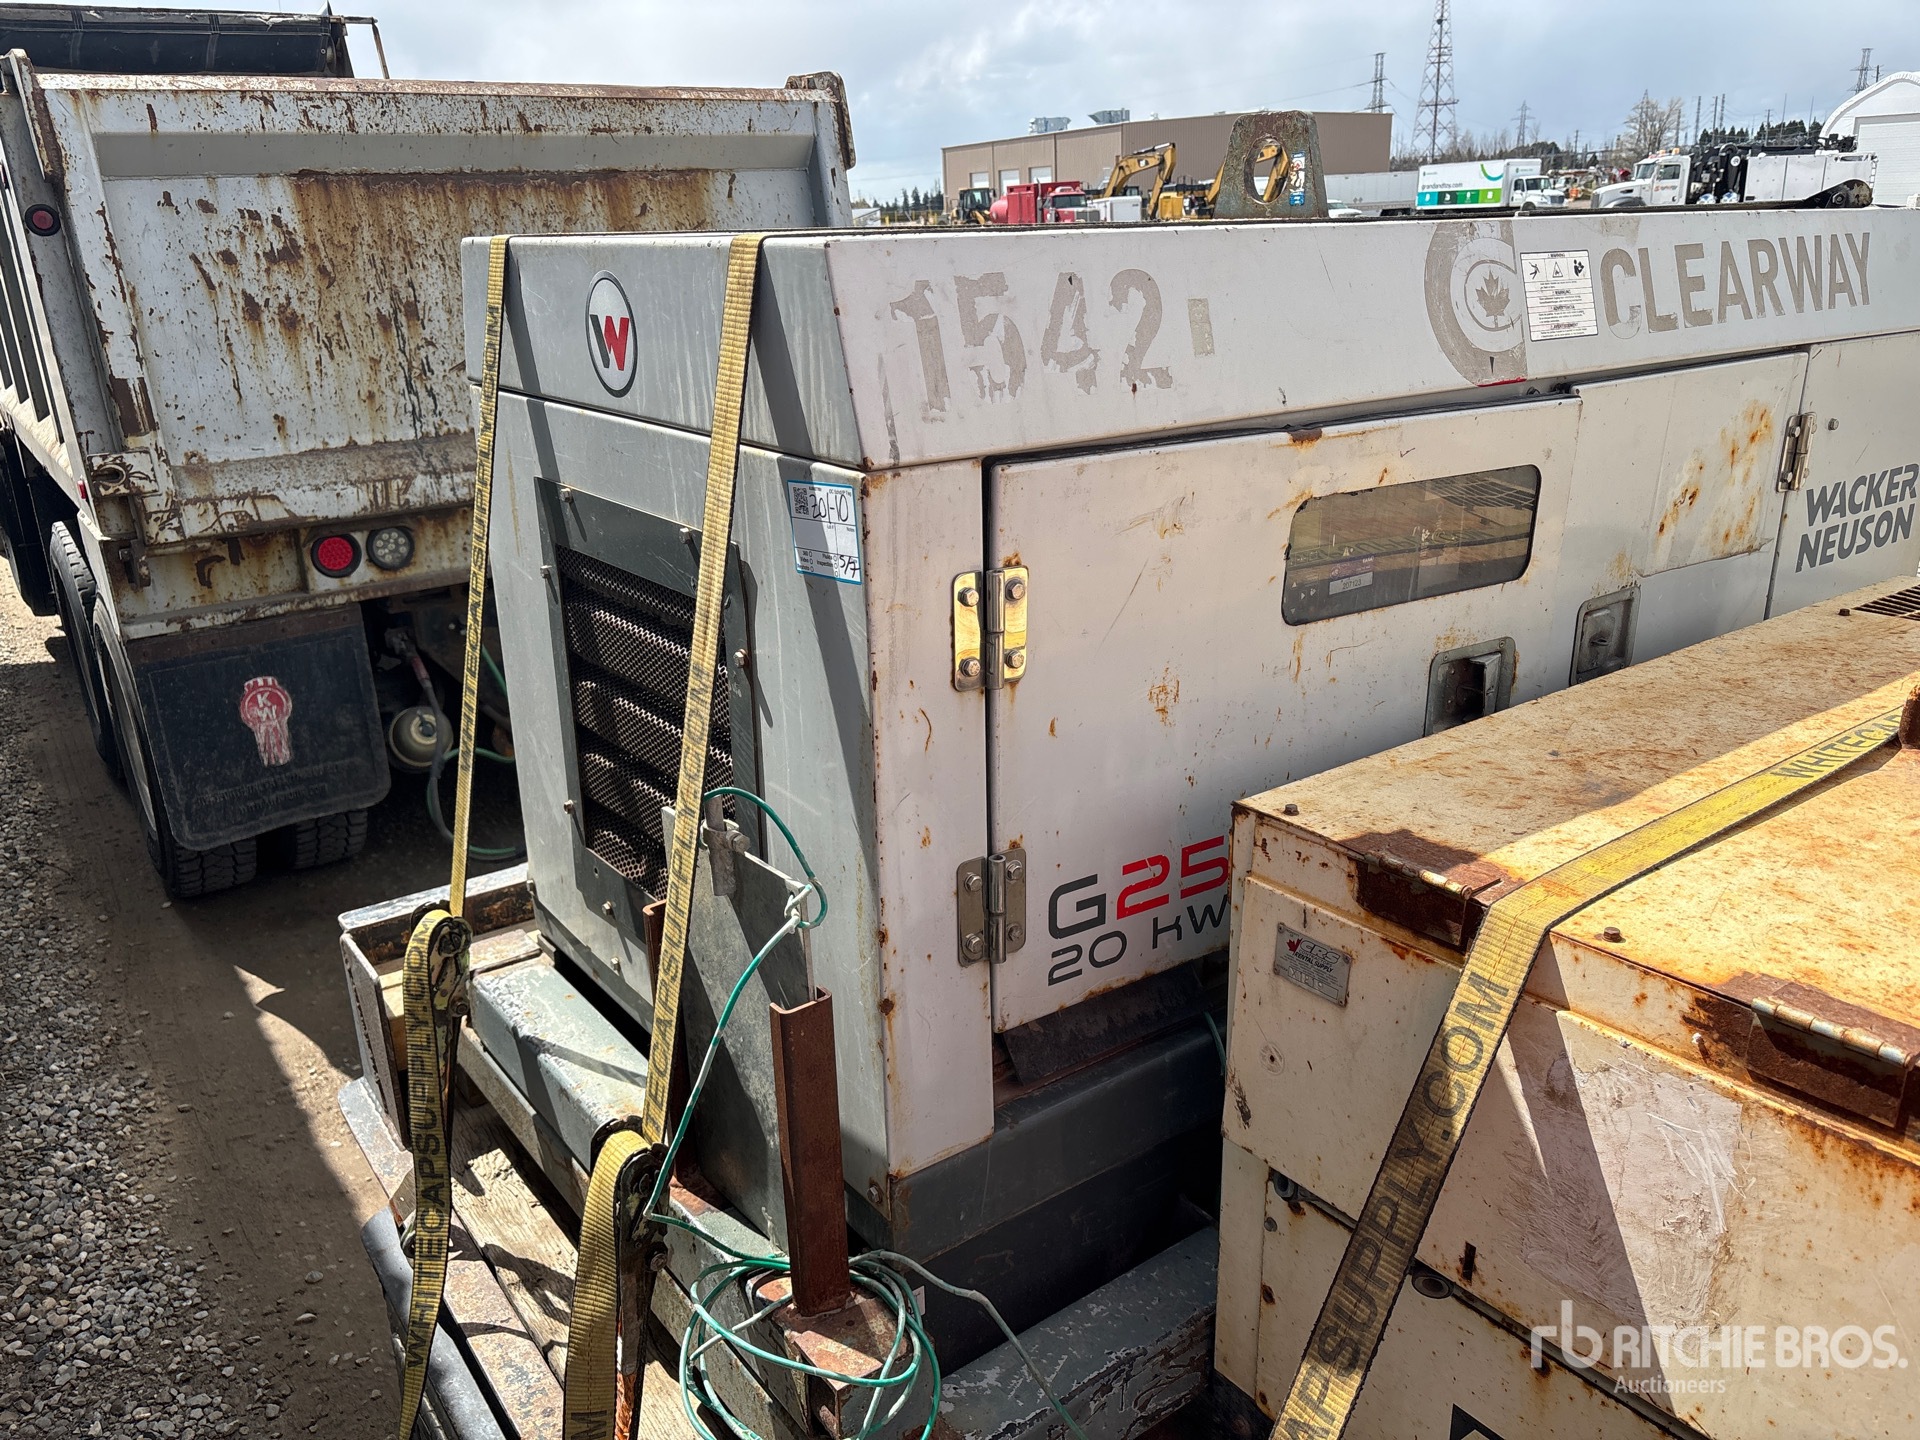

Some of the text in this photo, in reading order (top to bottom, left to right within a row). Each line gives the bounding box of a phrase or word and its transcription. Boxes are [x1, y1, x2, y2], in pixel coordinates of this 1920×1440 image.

[1600, 232, 1871, 338] CLEARWAY
[889, 268, 1174, 414] 1542
[1806, 463, 1920, 527] WACKER
[1795, 503, 1915, 573] NEUSON
[1048, 835, 1229, 940] G25
[1048, 930, 1127, 986] 20
[1294, 951, 1334, 973] RENTAL SUPPLY
[1300, 940, 1341, 964] CRS
